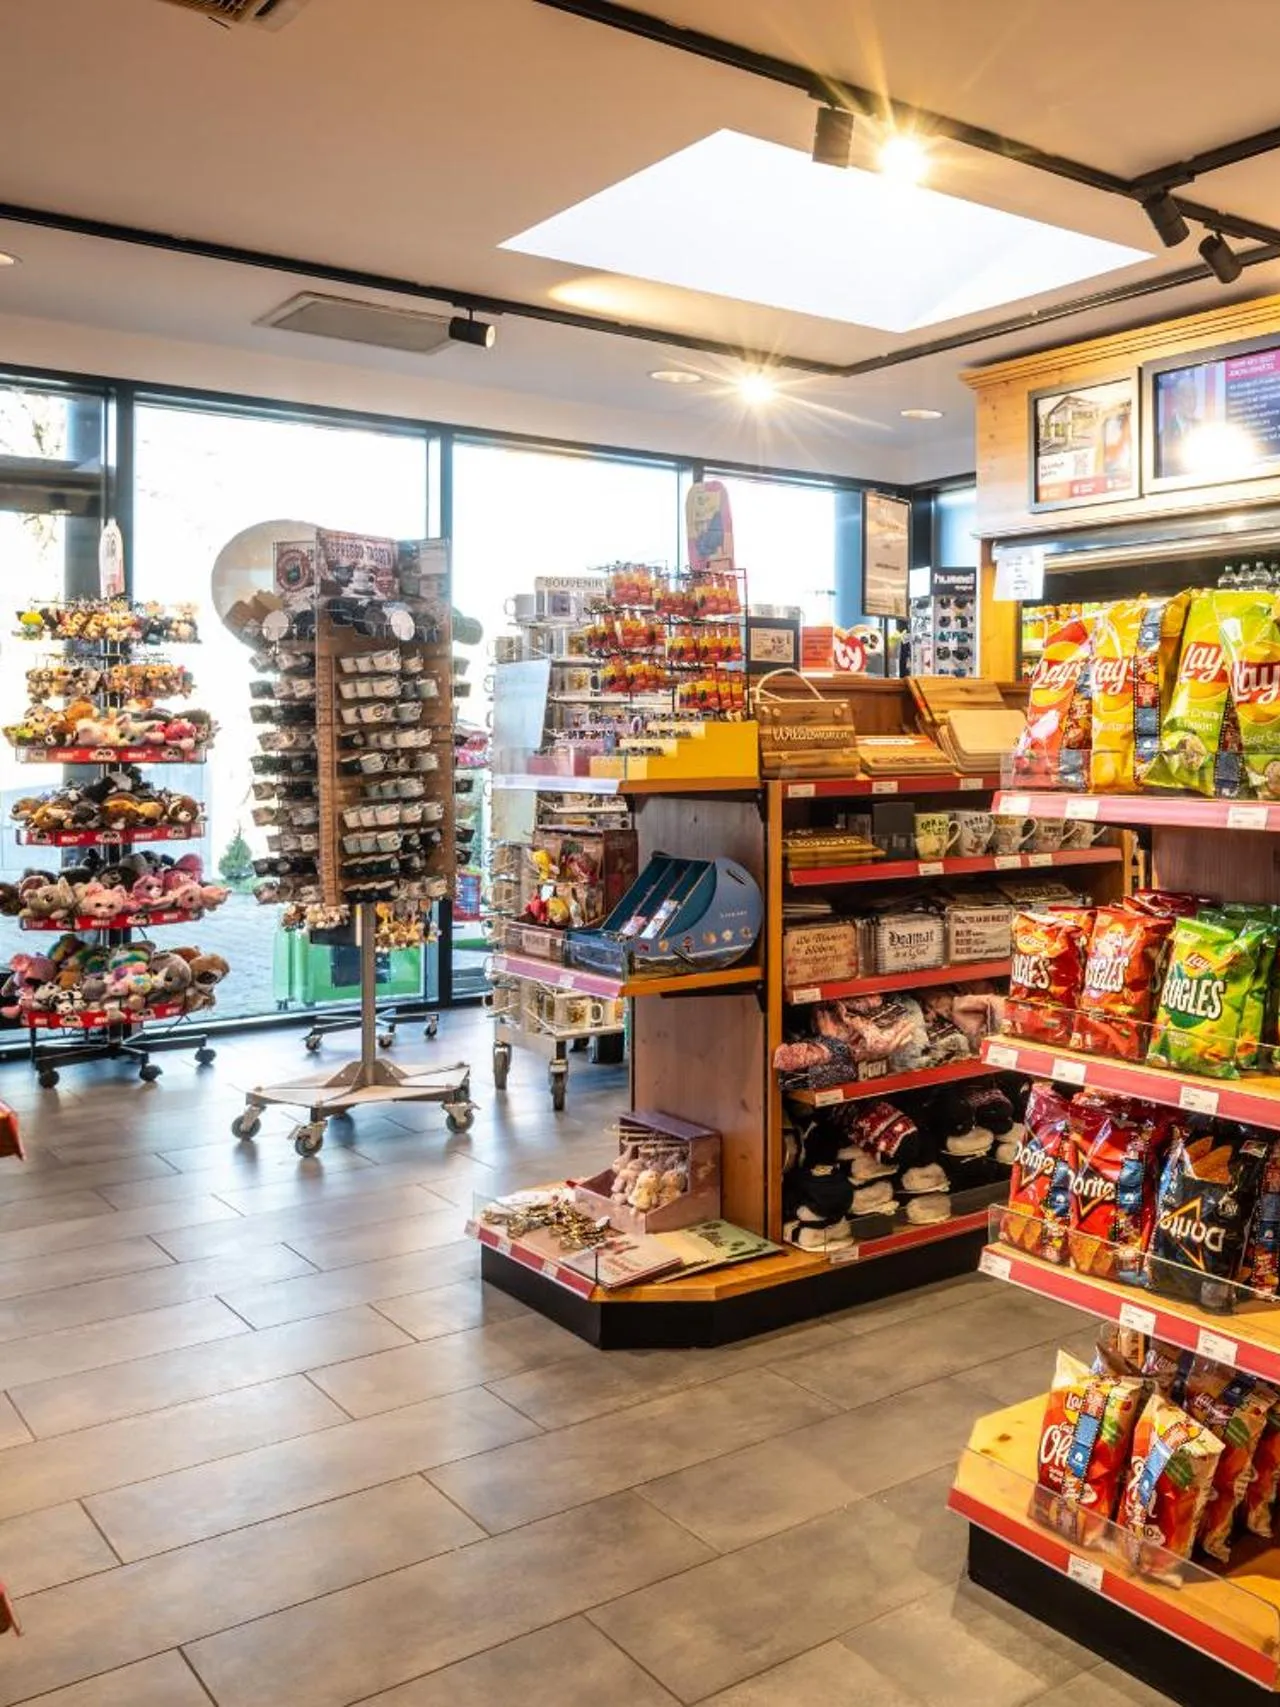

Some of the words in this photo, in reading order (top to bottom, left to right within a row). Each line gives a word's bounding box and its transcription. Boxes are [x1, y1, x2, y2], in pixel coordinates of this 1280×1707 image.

[838, 641, 863, 673] ty
[1160, 977, 1226, 1020] BUGLES
[1159, 1210, 1226, 1253] Dorito
